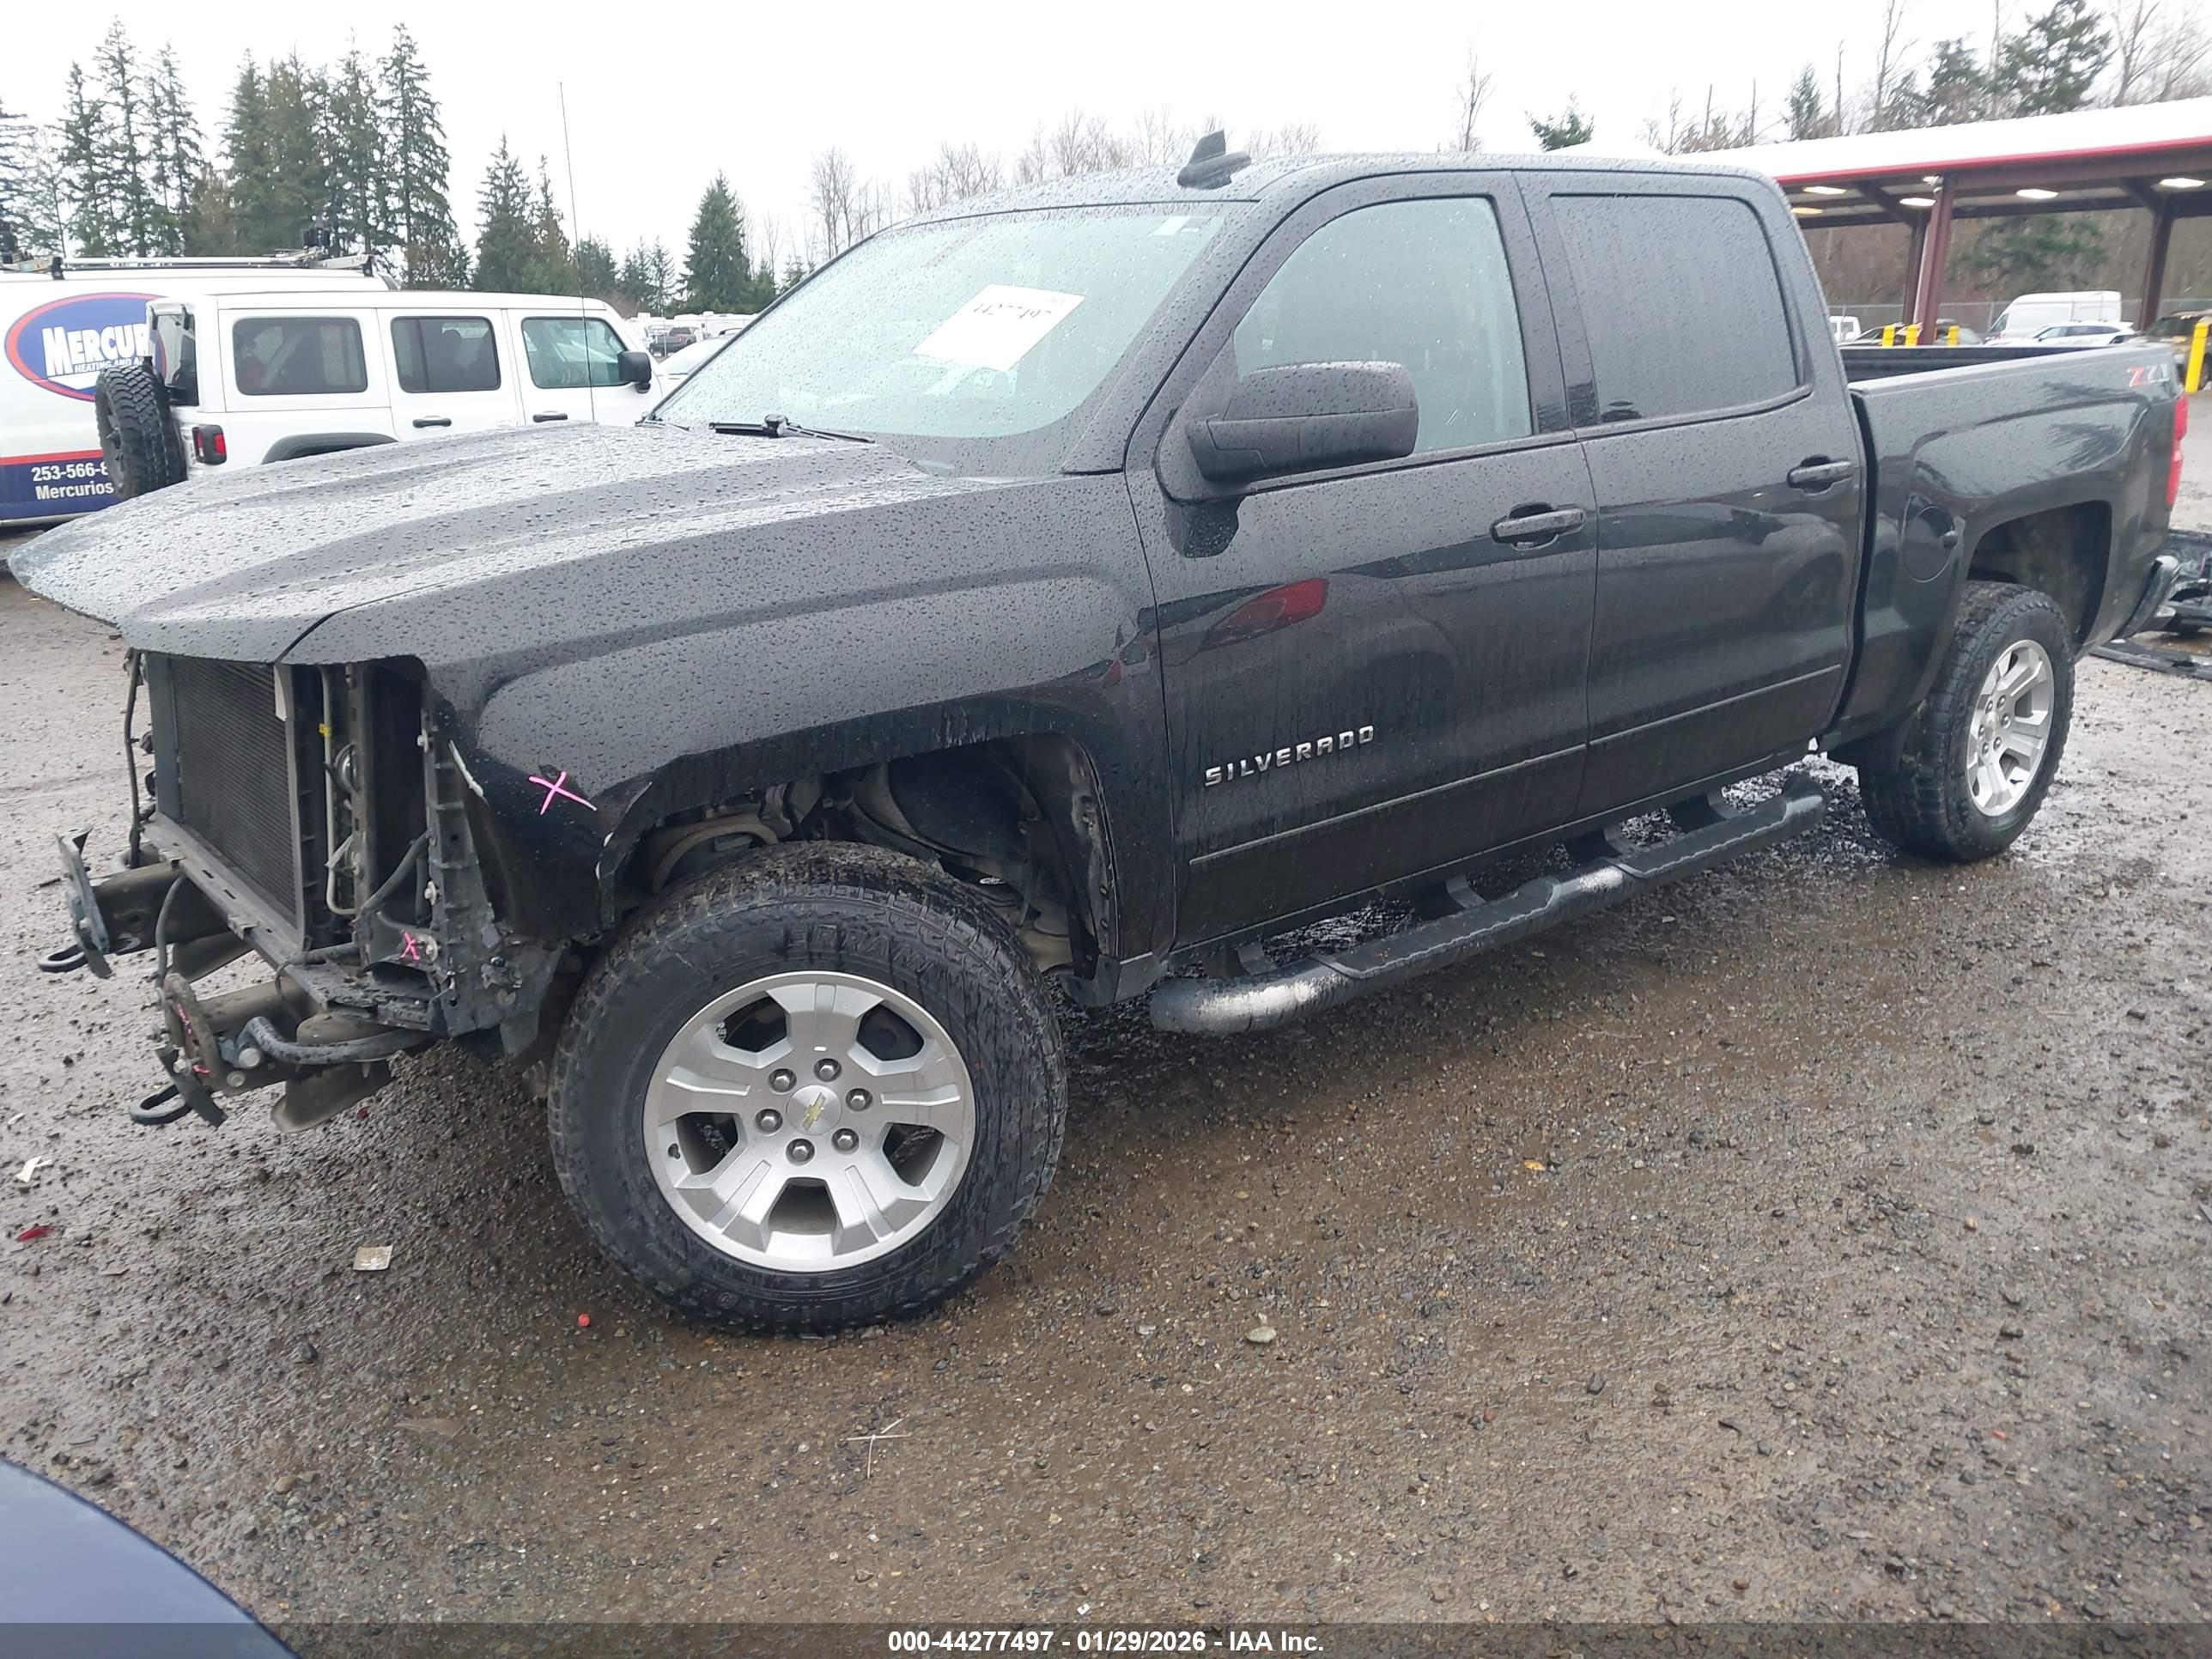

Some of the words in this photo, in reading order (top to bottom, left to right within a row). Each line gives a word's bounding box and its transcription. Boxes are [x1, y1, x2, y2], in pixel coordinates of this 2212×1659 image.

[74, 360, 112, 374] HEATING
[34, 480, 115, 500] Mercurios
[1205, 725, 1374, 787] SILVERADO
